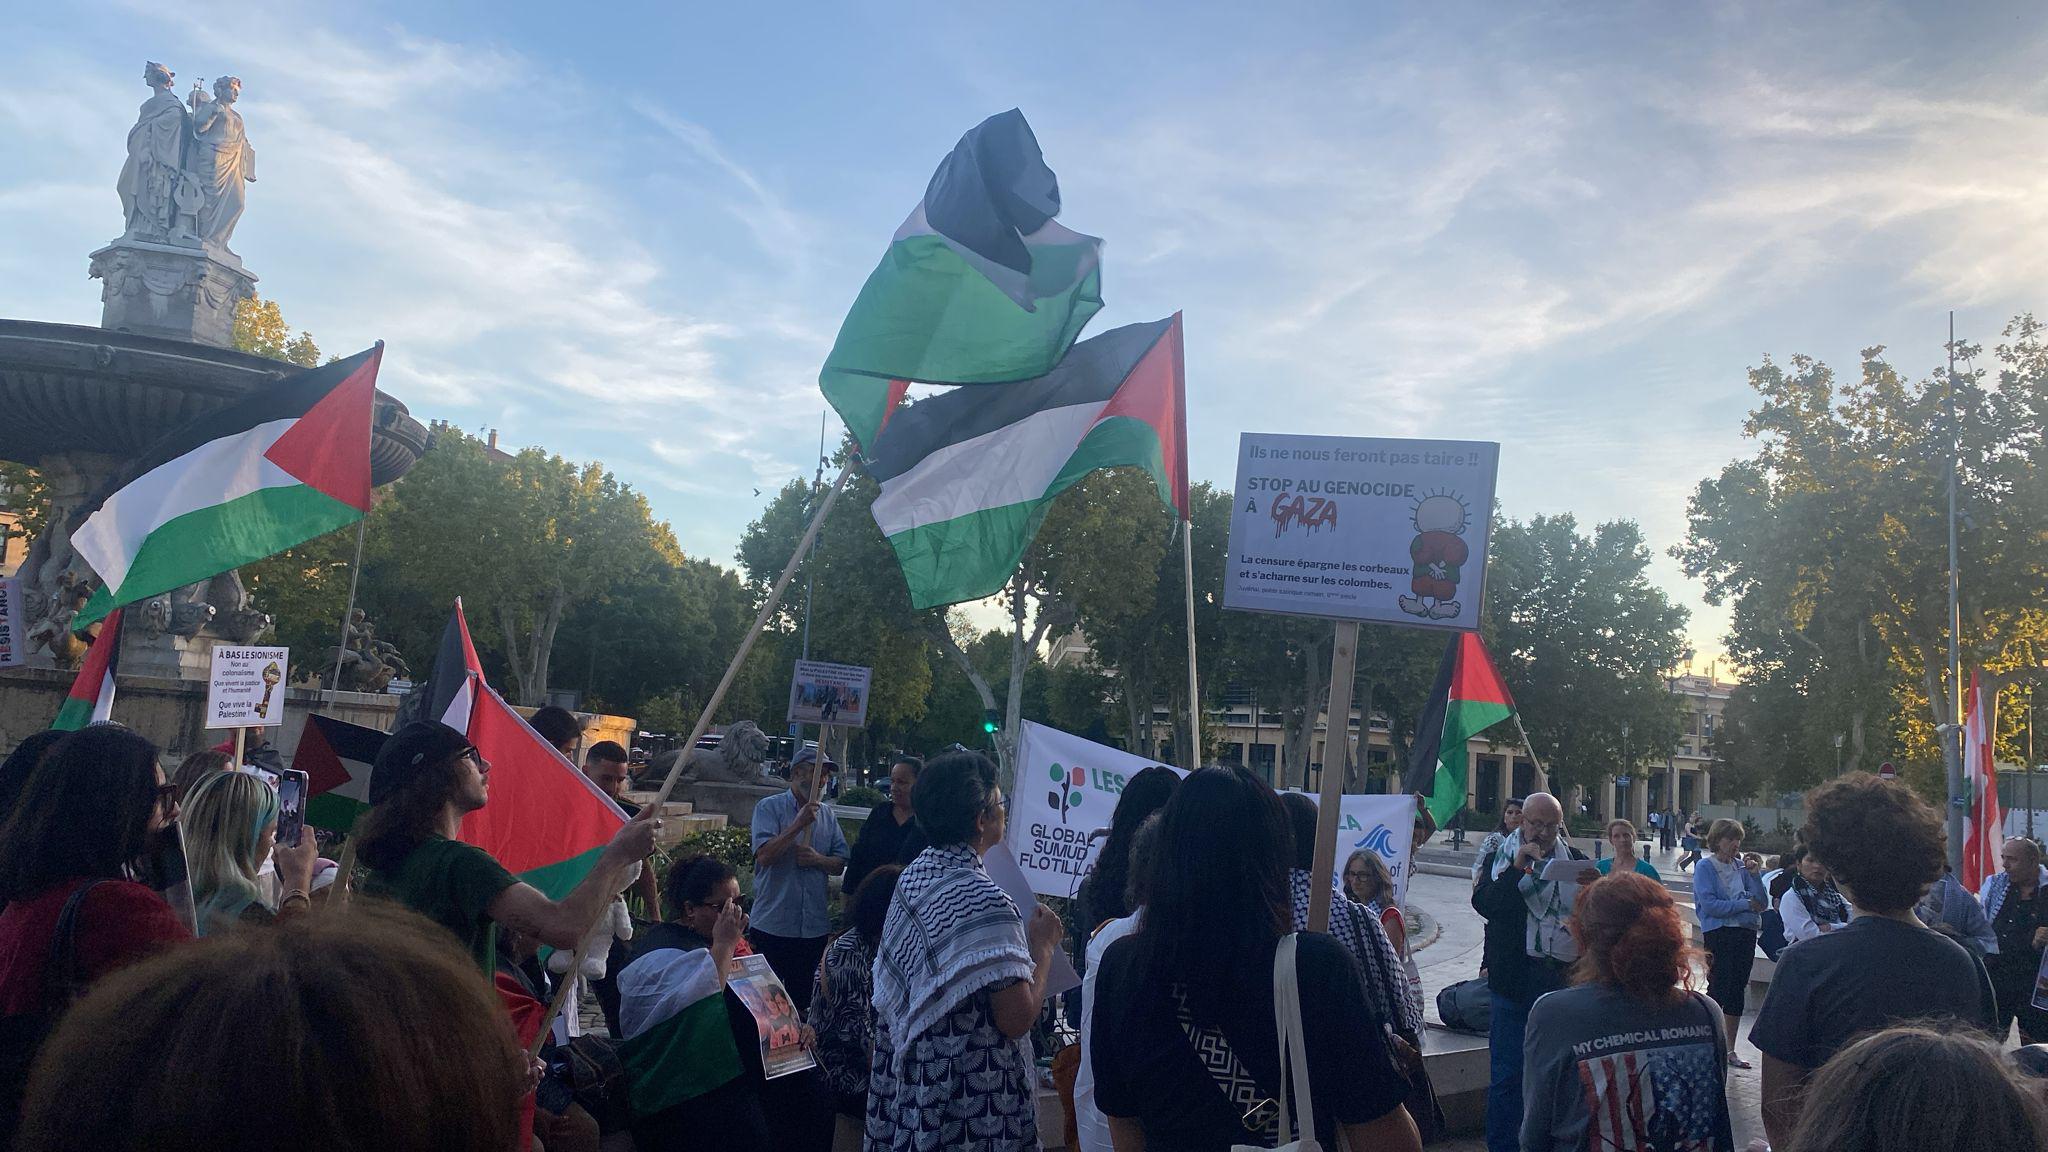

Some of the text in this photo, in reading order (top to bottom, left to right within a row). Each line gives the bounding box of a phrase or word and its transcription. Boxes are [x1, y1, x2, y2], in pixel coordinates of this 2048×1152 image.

[1250, 445, 1479, 467] Ils ne nous feront pas taire !!
[1248, 477, 1415, 498] STOP AU GENOCIDE
[1270, 492, 1338, 539] GAZA
[1241, 554, 1410, 576] La censure épargne les corbeaux
[1240, 570, 1393, 590] et s'acharne sur les colombes.
[218, 649, 284, 660] À BAS LE SIONISME
[218, 701, 231, 709] Que
[1092, 768, 1124, 794] LES
[1030, 823, 1096, 848] GLOBAL
[1034, 840, 1088, 860] SUMUD
[1020, 853, 1093, 877] FLOTILLA
[1391, 862, 1401, 877] of
[1572, 1025, 1712, 1056] MY CHEMICAL ROMANC
